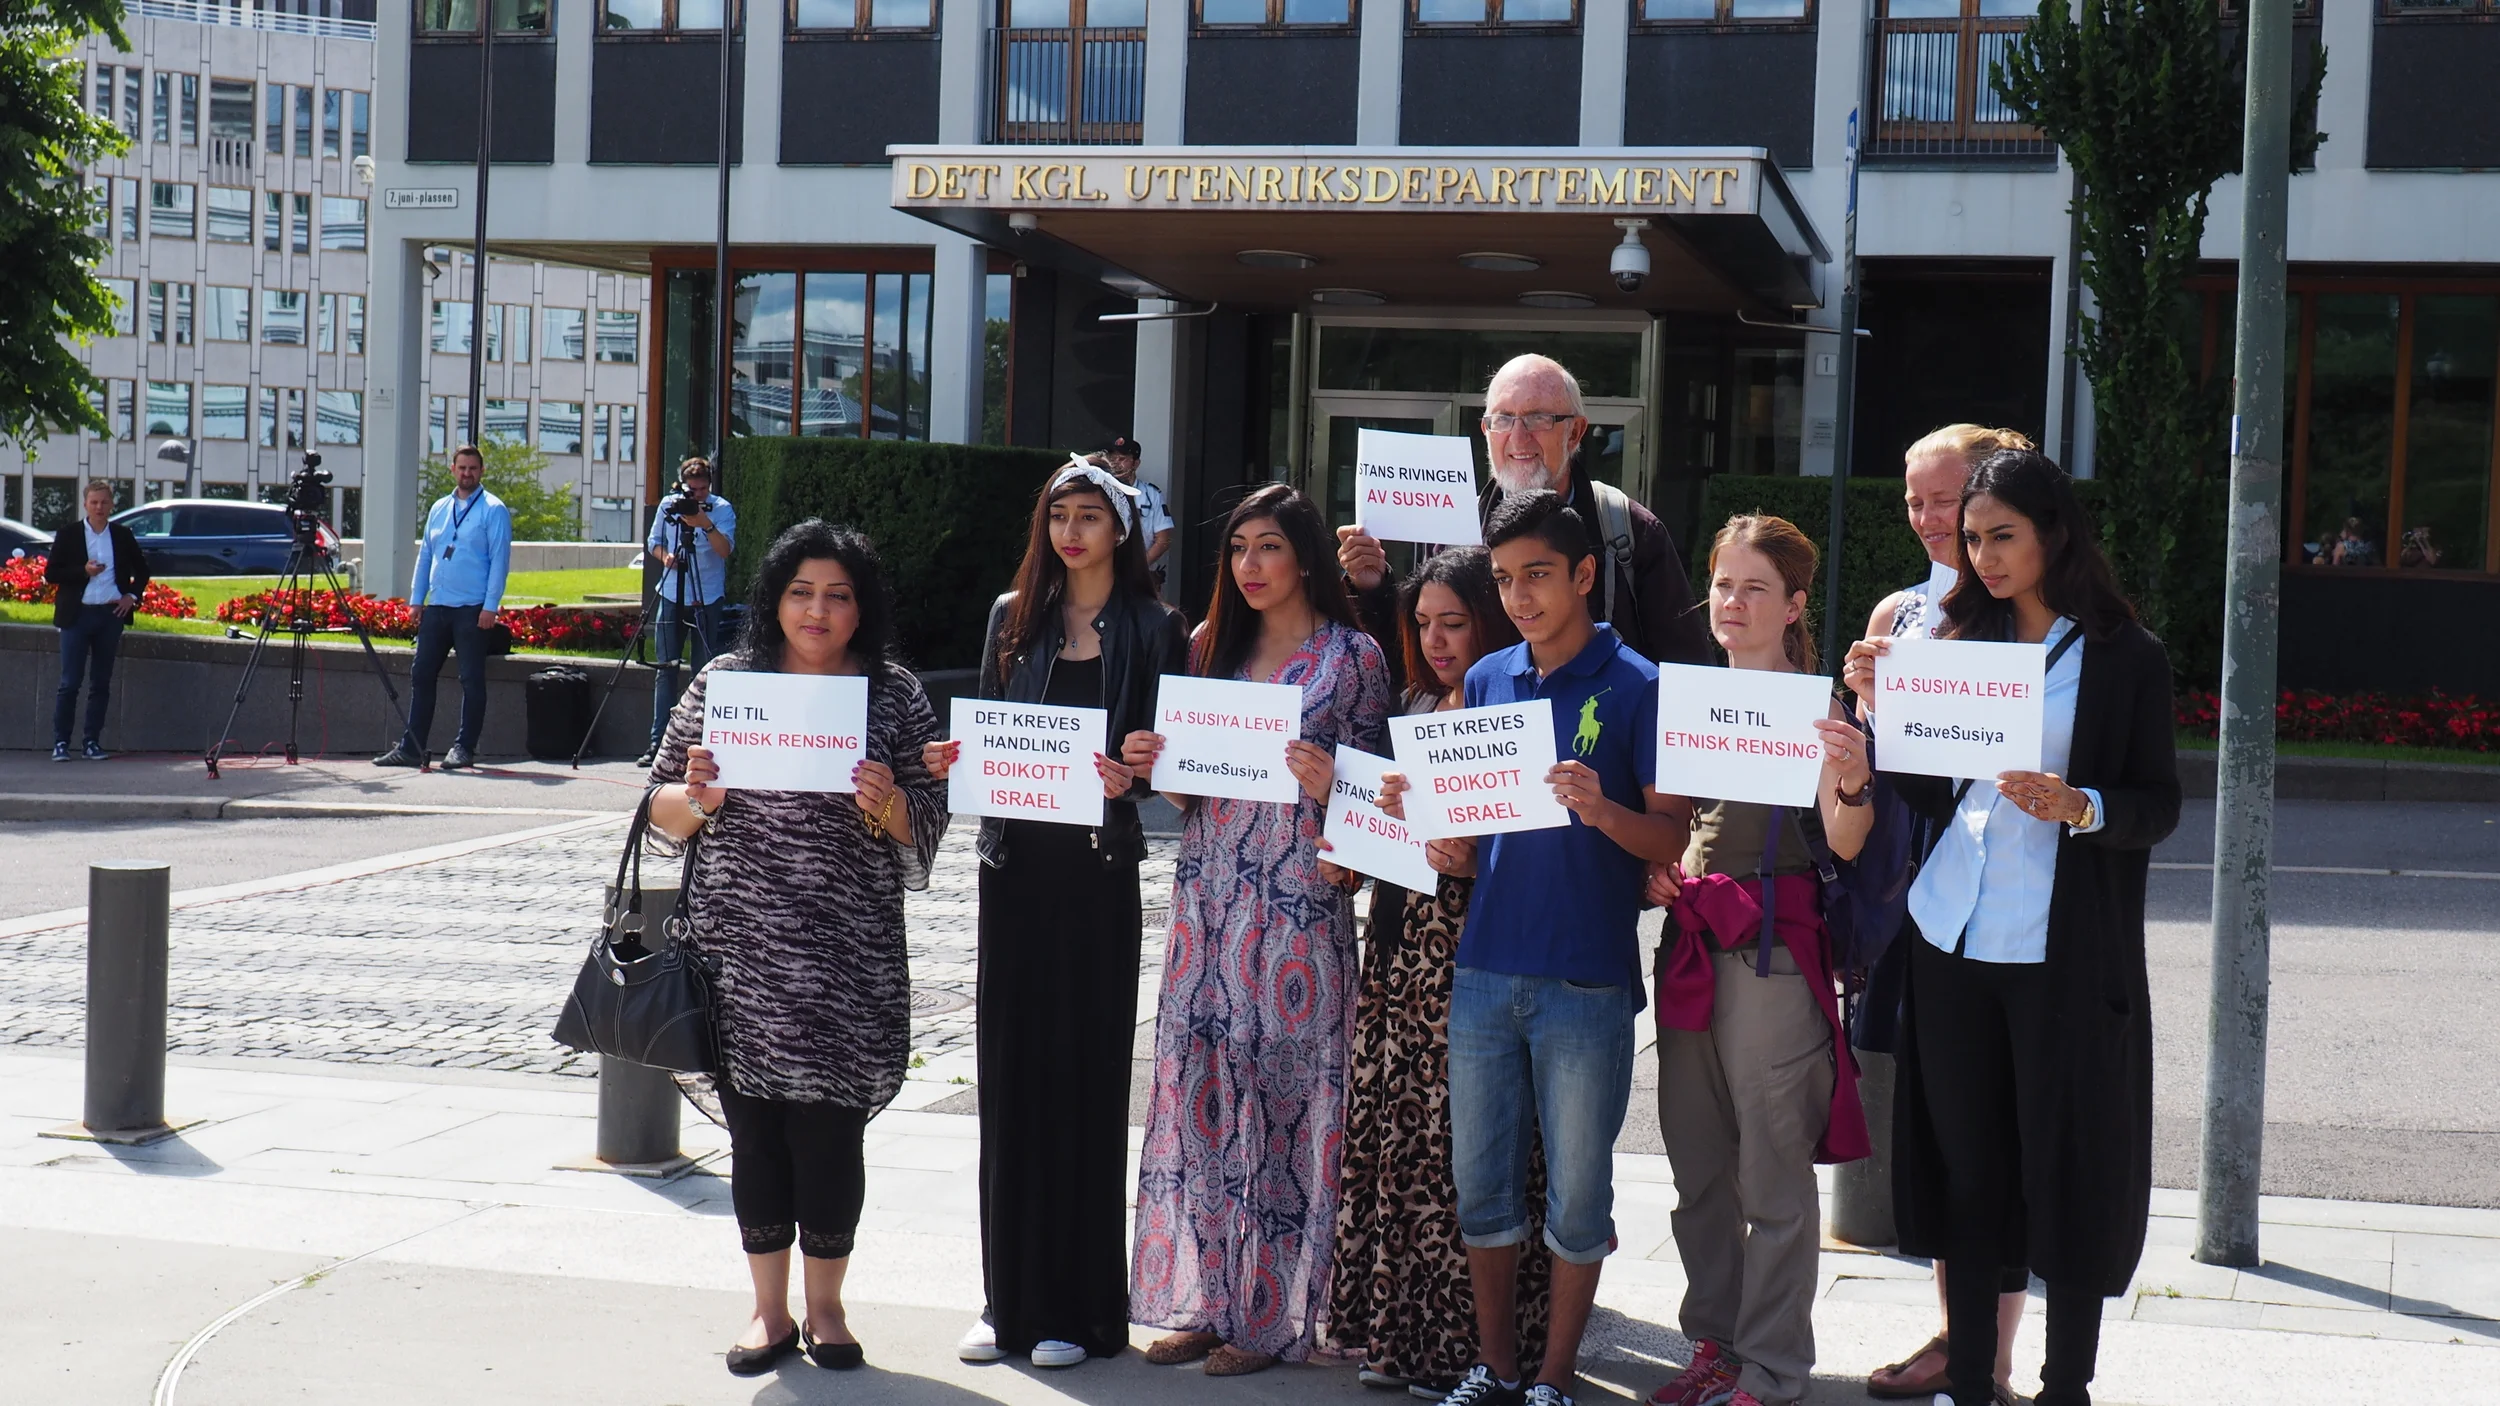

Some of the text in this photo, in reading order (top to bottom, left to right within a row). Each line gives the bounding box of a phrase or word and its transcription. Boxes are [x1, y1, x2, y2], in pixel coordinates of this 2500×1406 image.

[906, 163, 1738, 206] DET KGL. UTENRIKSDEPARTEMENT
[390, 191, 397, 203] 7.
[1823, 356, 1830, 373] 1
[1358, 462, 1468, 484] STANS RIVINGEN
[1367, 488, 1454, 509] AV SUSIYA
[1884, 676, 2029, 699] LA SUSIYA LEVE!
[711, 705, 769, 721] NEI TIL
[976, 710, 1081, 731] DET KREVES
[1164, 709, 1288, 733] LA SUSIYA LEVE!
[1710, 707, 1772, 728] NEI TIL
[1415, 714, 1525, 741] DET KREVES
[1904, 722, 2004, 746] #SaveSusiya
[709, 730, 858, 750] ETNISK RENSING
[984, 734, 1071, 754] HANDLING
[1665, 731, 1819, 760] ETNISK RENSING
[1427, 741, 1518, 765] HANDLING
[983, 760, 1070, 782] BOIKOTT
[1178, 759, 1268, 780] #SaveSusiya
[1335, 779, 1375, 804] STANS
[1434, 769, 1521, 794] BOIKOTT
[991, 789, 1061, 810] ISRAEL
[1344, 810, 1365, 829] AV
[1447, 801, 1522, 824] ISRAEL
